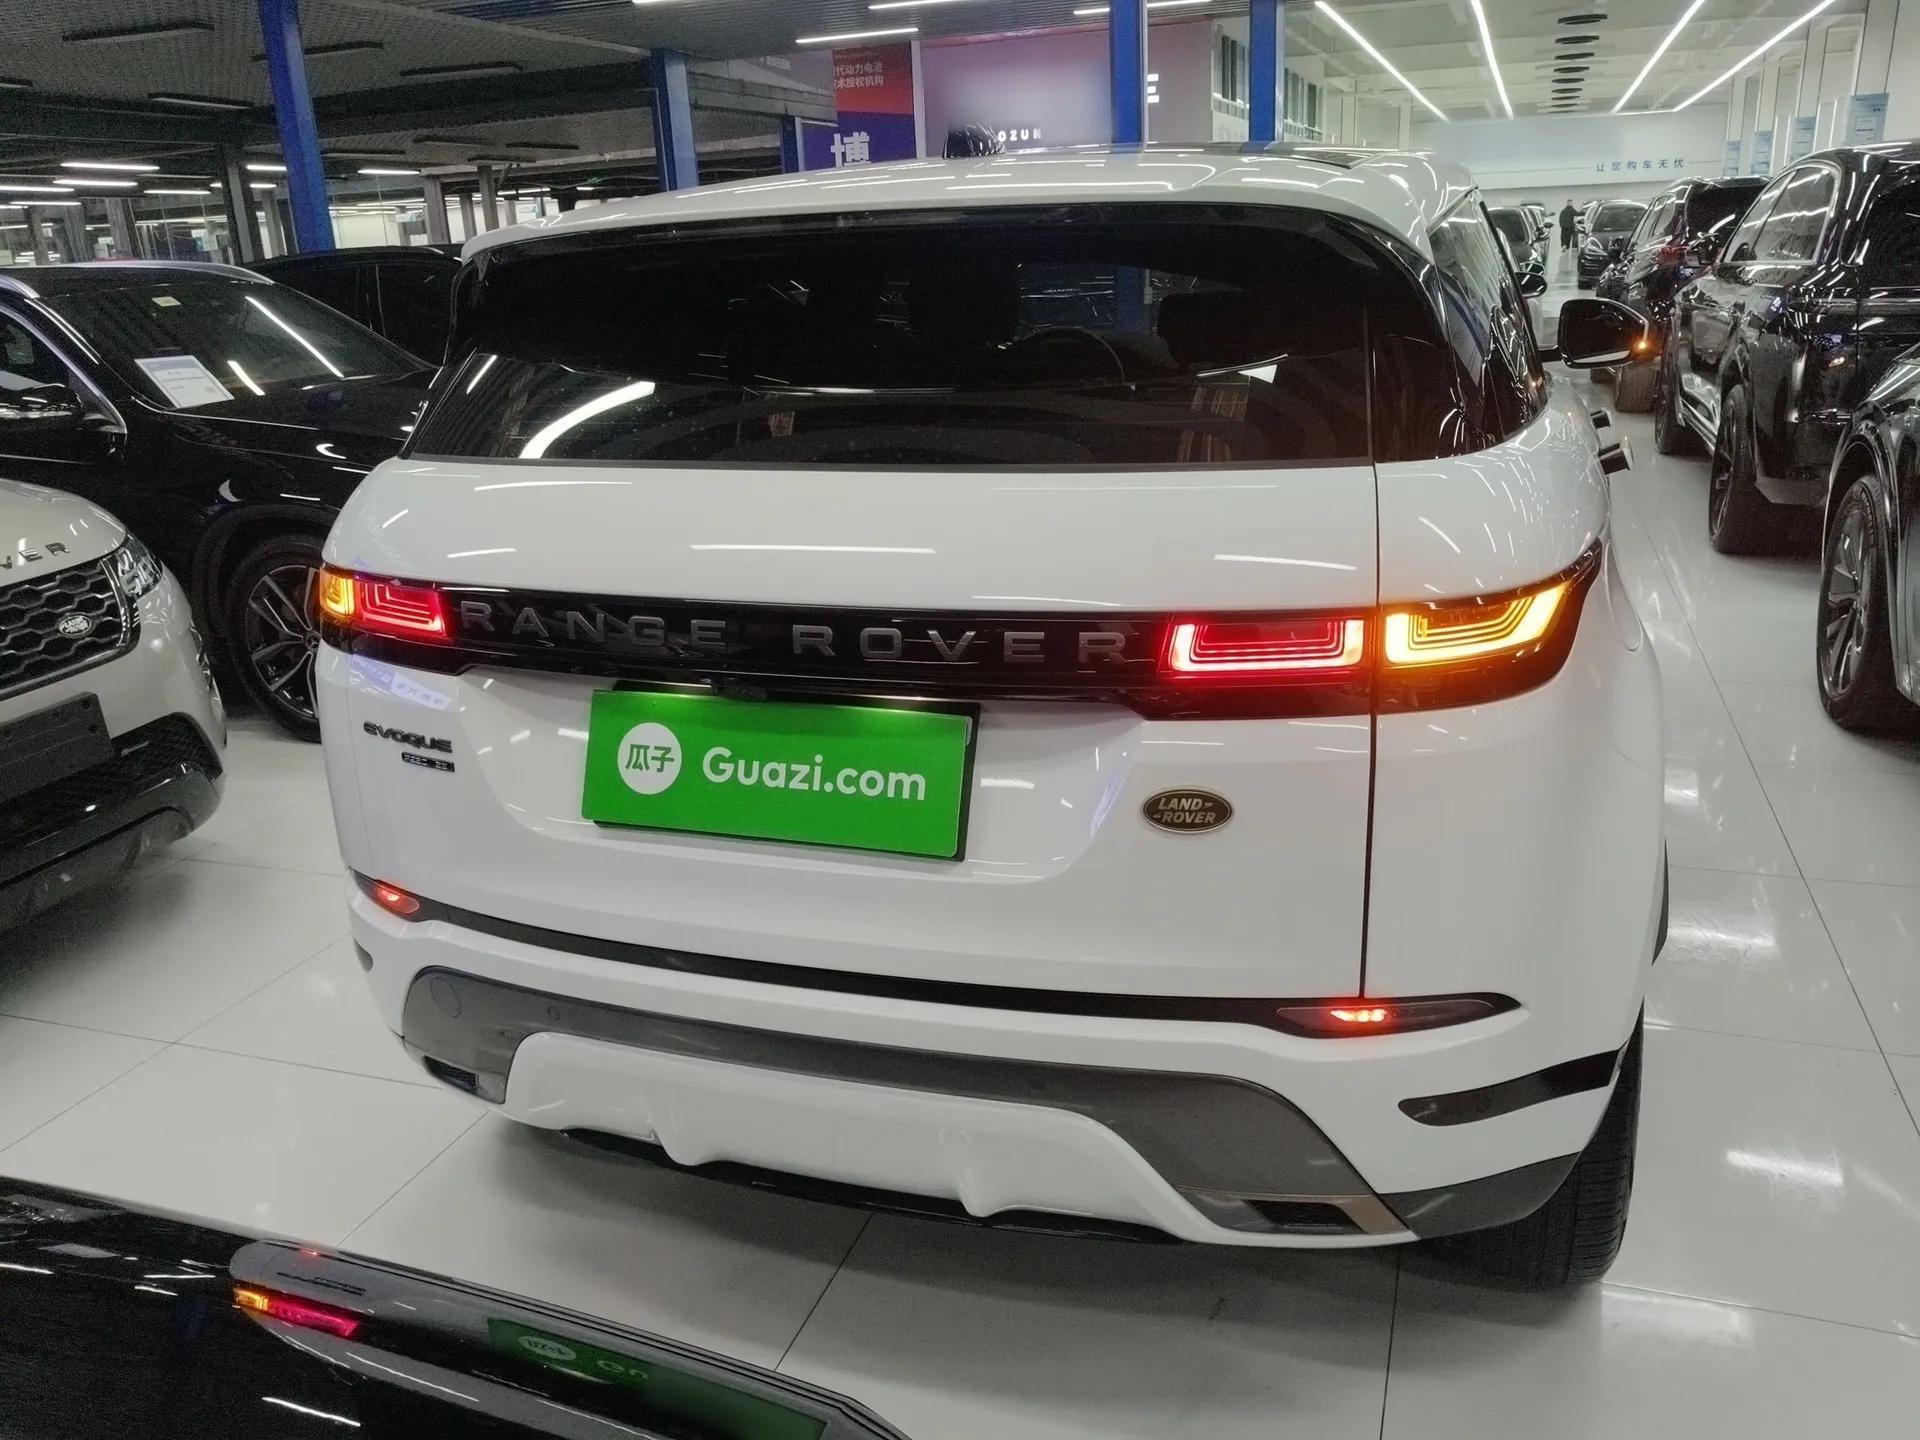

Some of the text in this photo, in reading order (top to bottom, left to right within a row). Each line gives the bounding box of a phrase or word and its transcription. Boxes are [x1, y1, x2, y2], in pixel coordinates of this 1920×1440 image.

[461, 600, 1127, 664] RANGE ROVER
[363, 721, 453, 754] EVOQUE
[625, 744, 675, 773] 瓜子
[702, 746, 926, 801] Guazi.com
